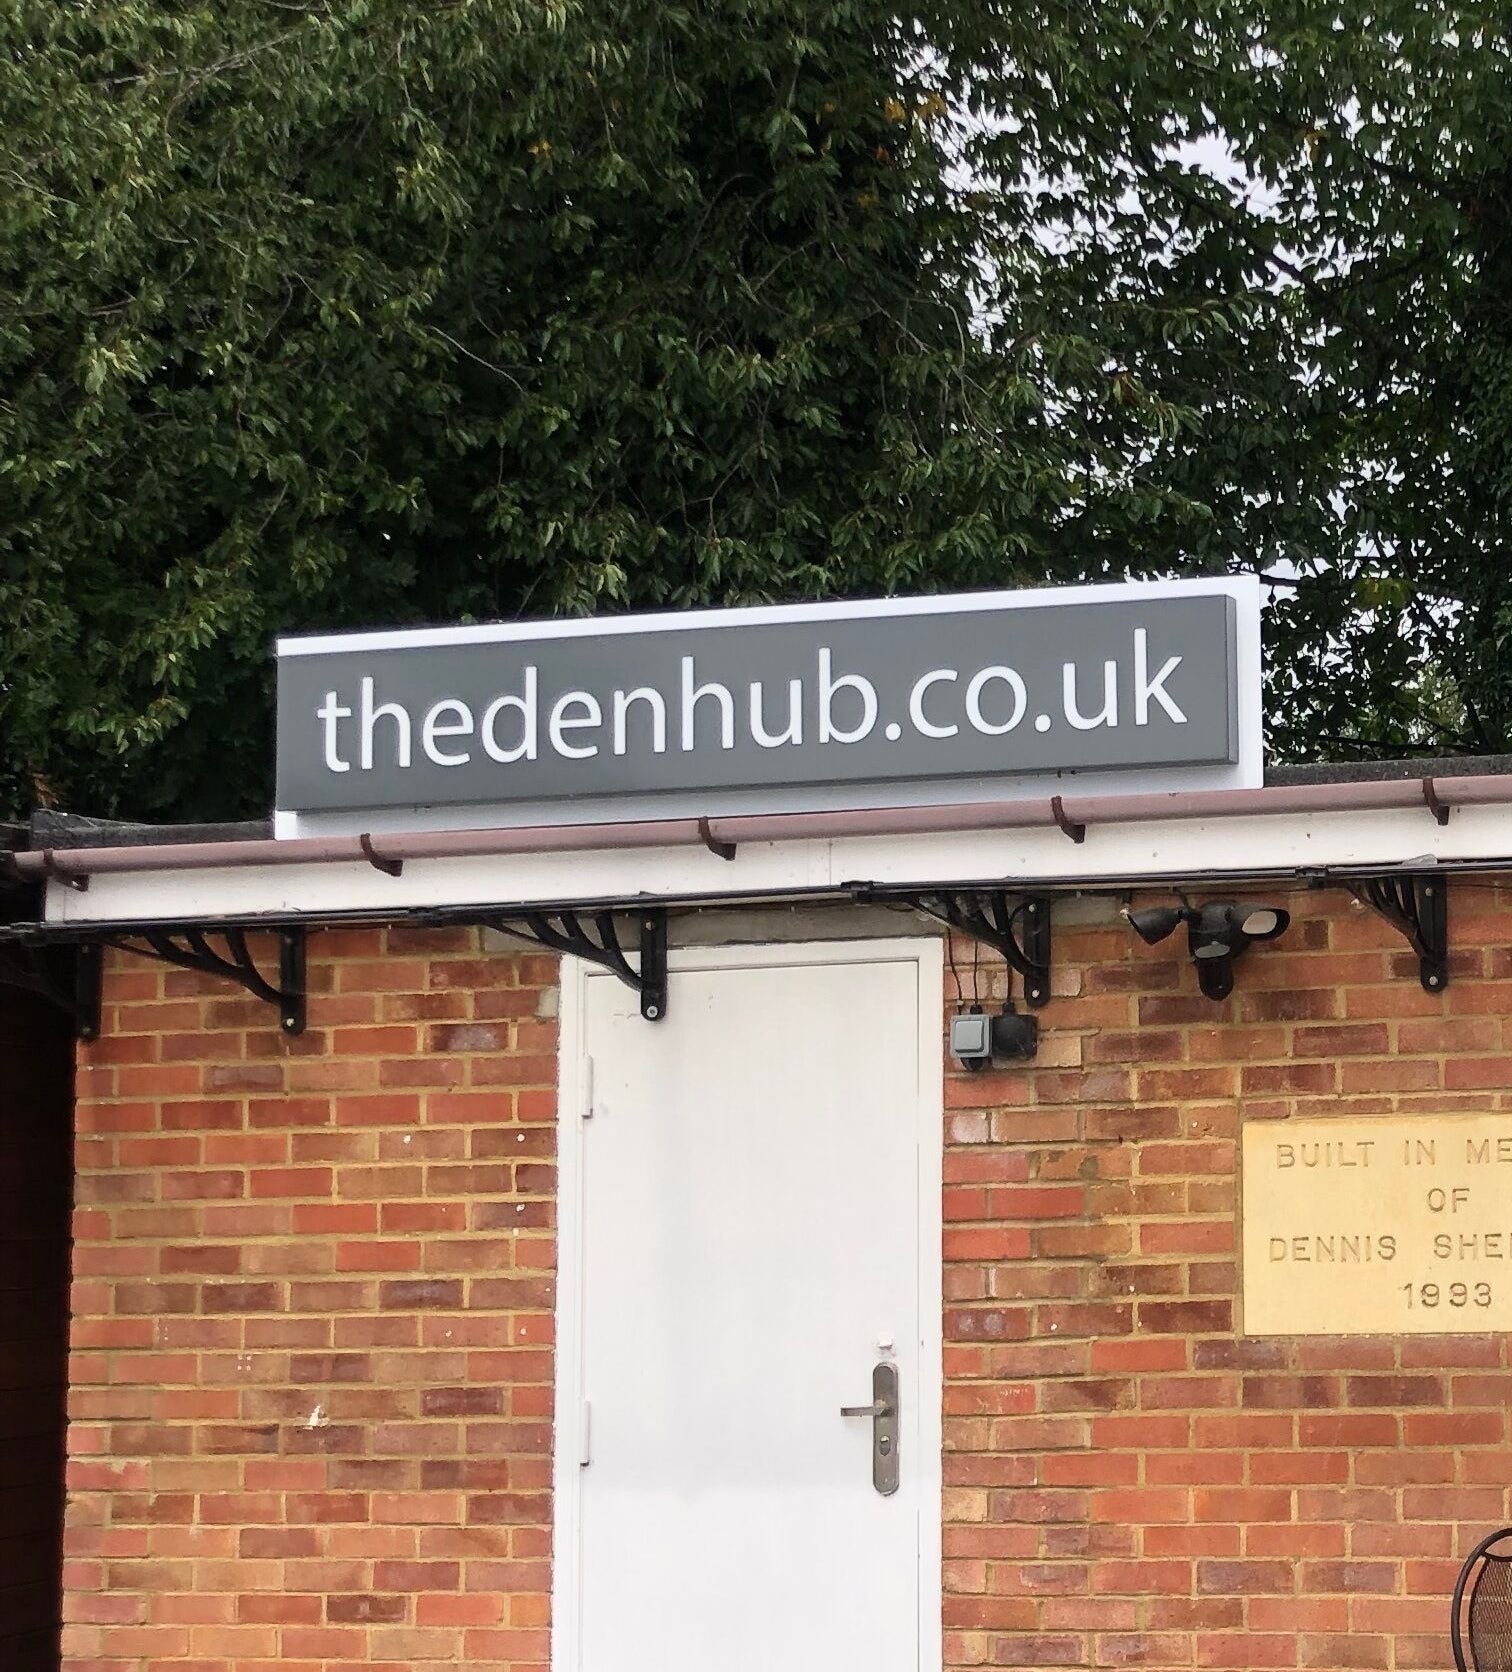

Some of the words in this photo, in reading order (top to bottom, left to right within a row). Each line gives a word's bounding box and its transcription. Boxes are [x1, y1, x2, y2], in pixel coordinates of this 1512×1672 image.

[316, 628, 1188, 774] thedenhub.co.uk
[1276, 1141, 1375, 1169] BUILT
[1403, 1139, 1436, 1166] IN
[1426, 1187, 1471, 1213] OF
[1269, 1235, 1397, 1263] DENNIS
[1402, 1282, 1493, 1309] 1993
